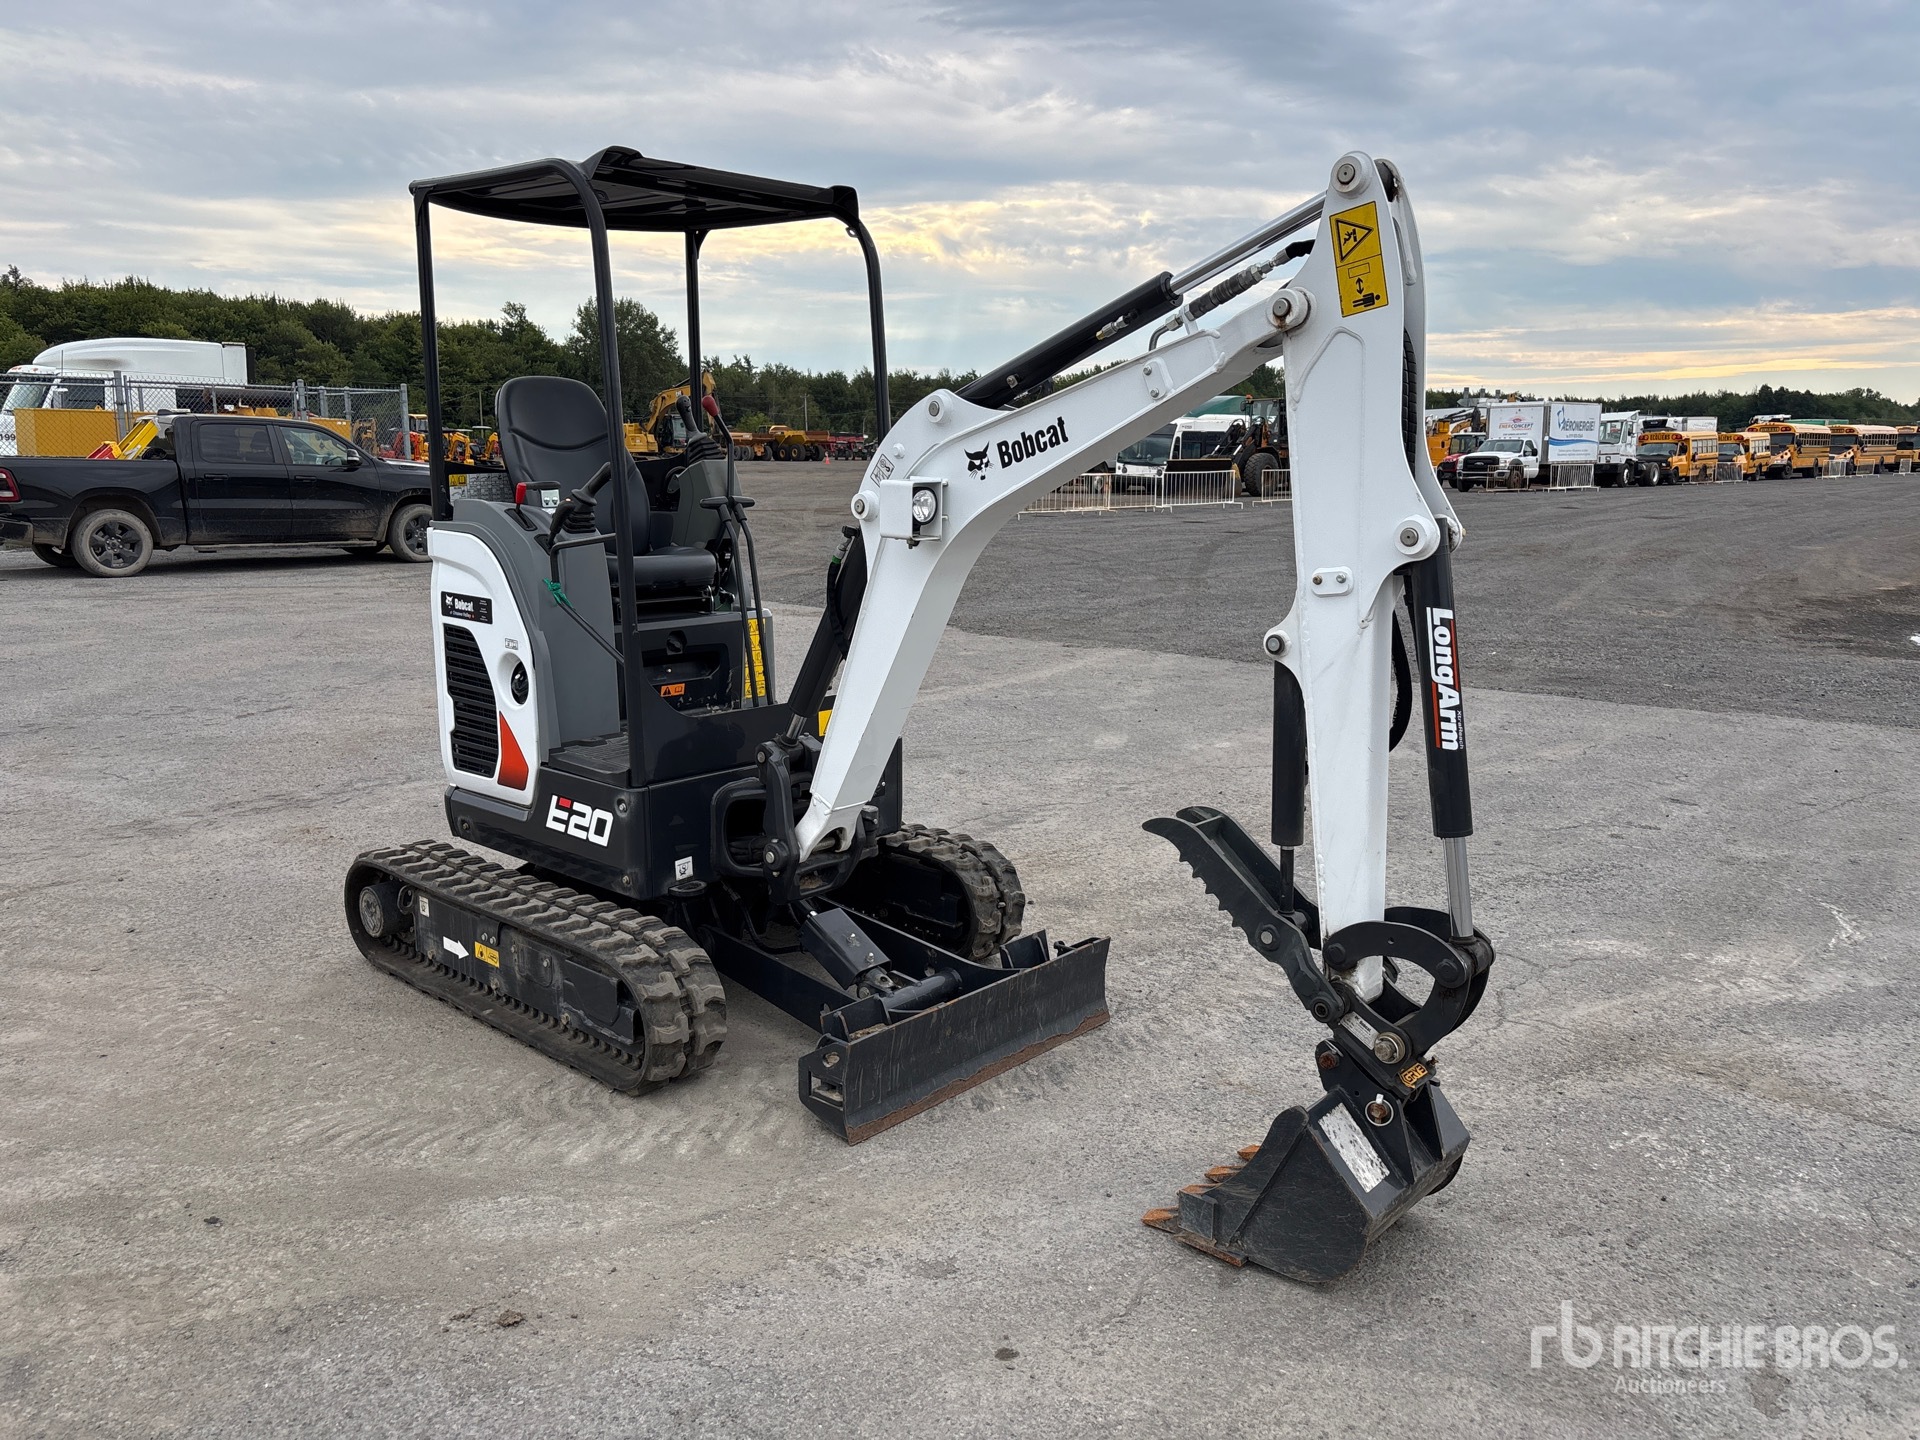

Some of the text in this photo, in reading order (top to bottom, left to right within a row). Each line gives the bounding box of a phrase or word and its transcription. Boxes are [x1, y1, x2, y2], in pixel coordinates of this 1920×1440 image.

[996, 416, 1069, 469] Bobcat
[454, 598, 474, 612] Bobcat
[1426, 607, 1461, 751] LongArm
[1456, 710, 1464, 750] XtraReach
[546, 794, 614, 847] E20
